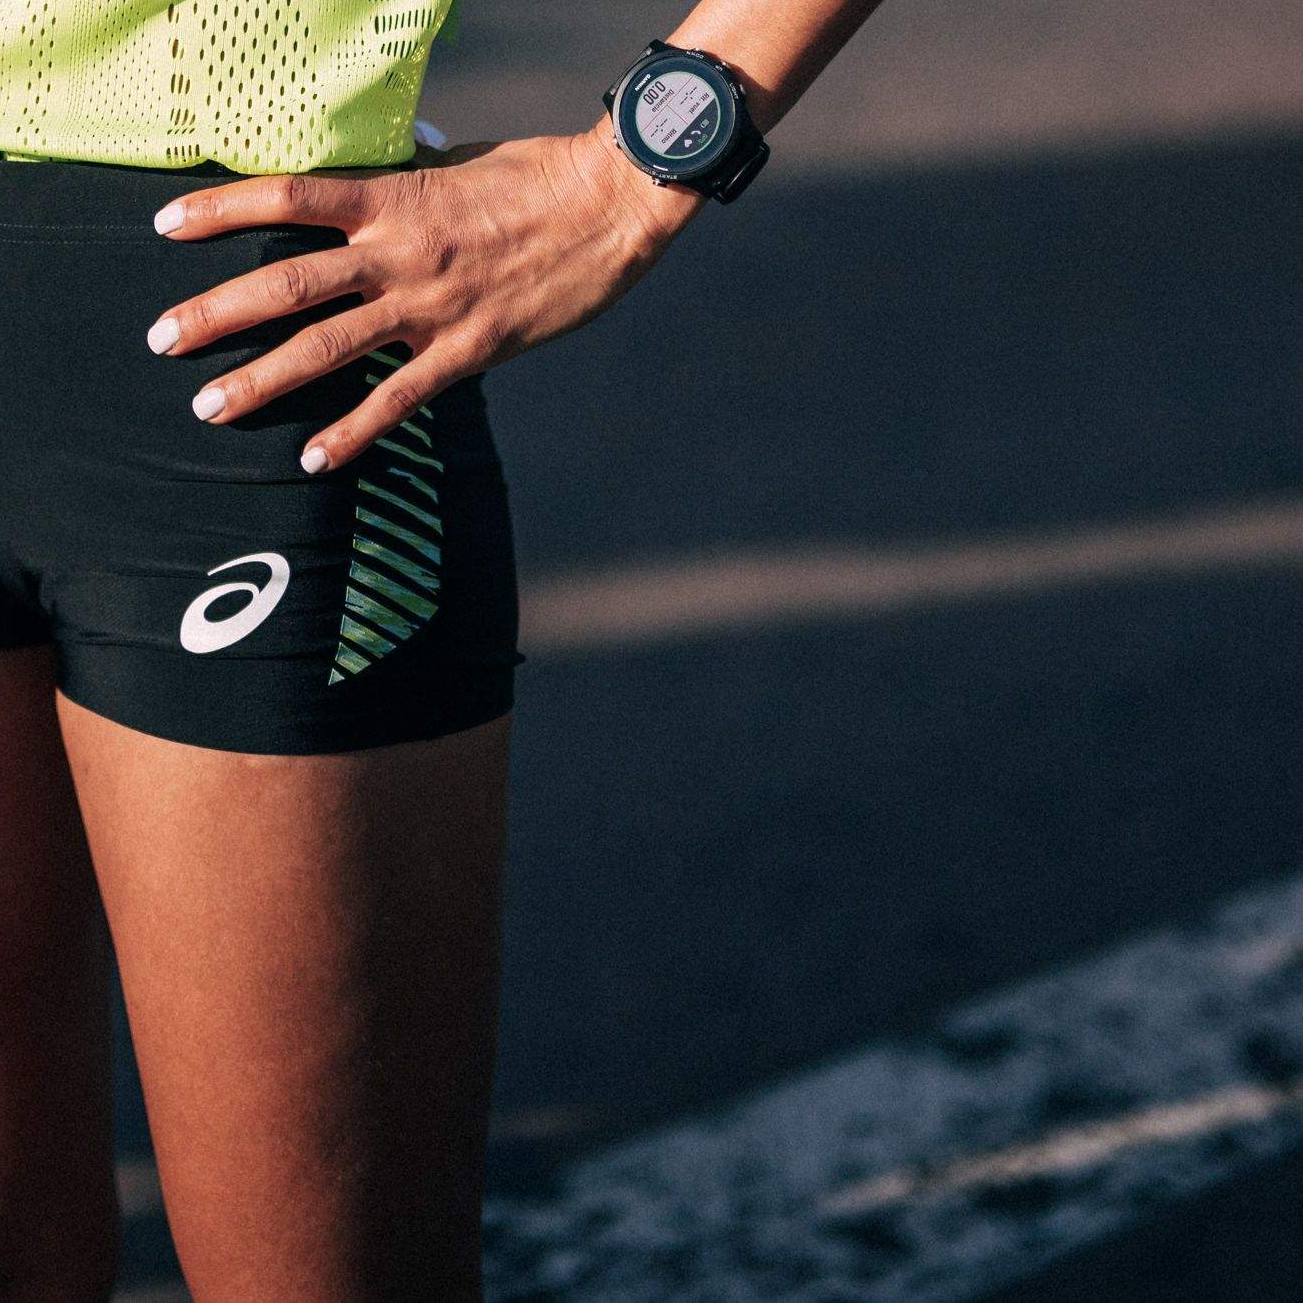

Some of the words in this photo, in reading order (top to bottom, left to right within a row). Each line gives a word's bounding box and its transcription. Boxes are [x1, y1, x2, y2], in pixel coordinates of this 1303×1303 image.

[643, 81, 666, 105] 0.00
[651, 89, 675, 113] Distancia
[661, 128, 678, 144] Ritmo
